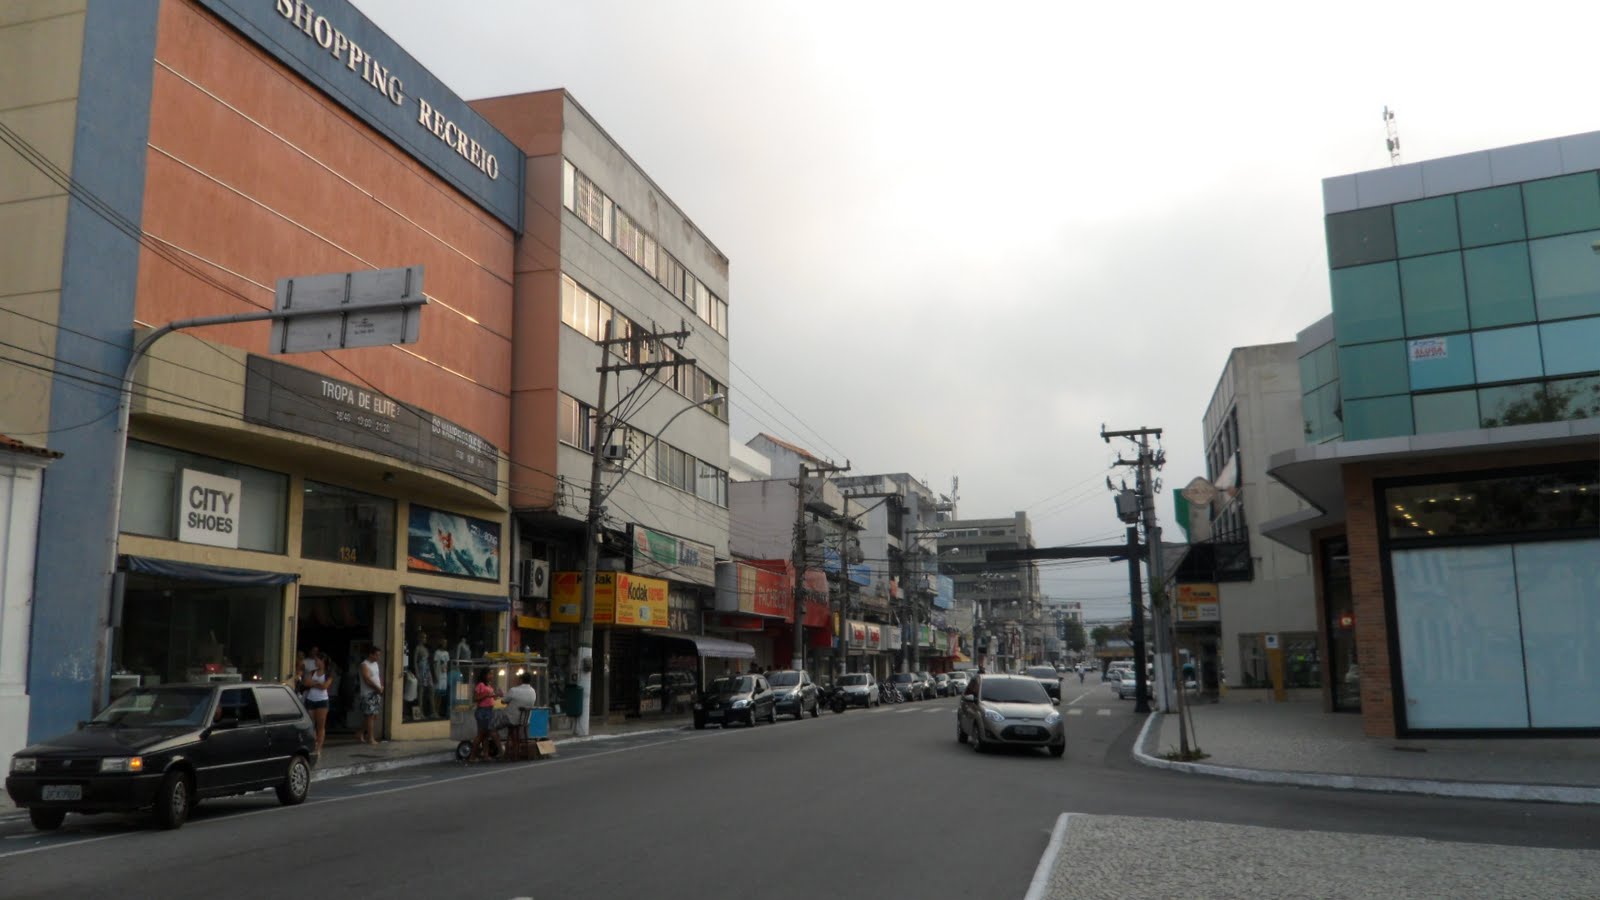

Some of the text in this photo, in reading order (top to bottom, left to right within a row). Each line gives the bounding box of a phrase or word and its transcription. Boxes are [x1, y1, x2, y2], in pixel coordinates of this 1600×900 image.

[277, 0, 499, 181] SHOPPING RECREIO
[321, 380, 354, 405] TROPA
[358, 391, 371, 410] DE
[373, 397, 396, 418] ELITE
[189, 485, 234, 514] CITY
[187, 511, 233, 534] SHOES
[339, 545, 357, 563] 134
[627, 582, 648, 602] Kodak
